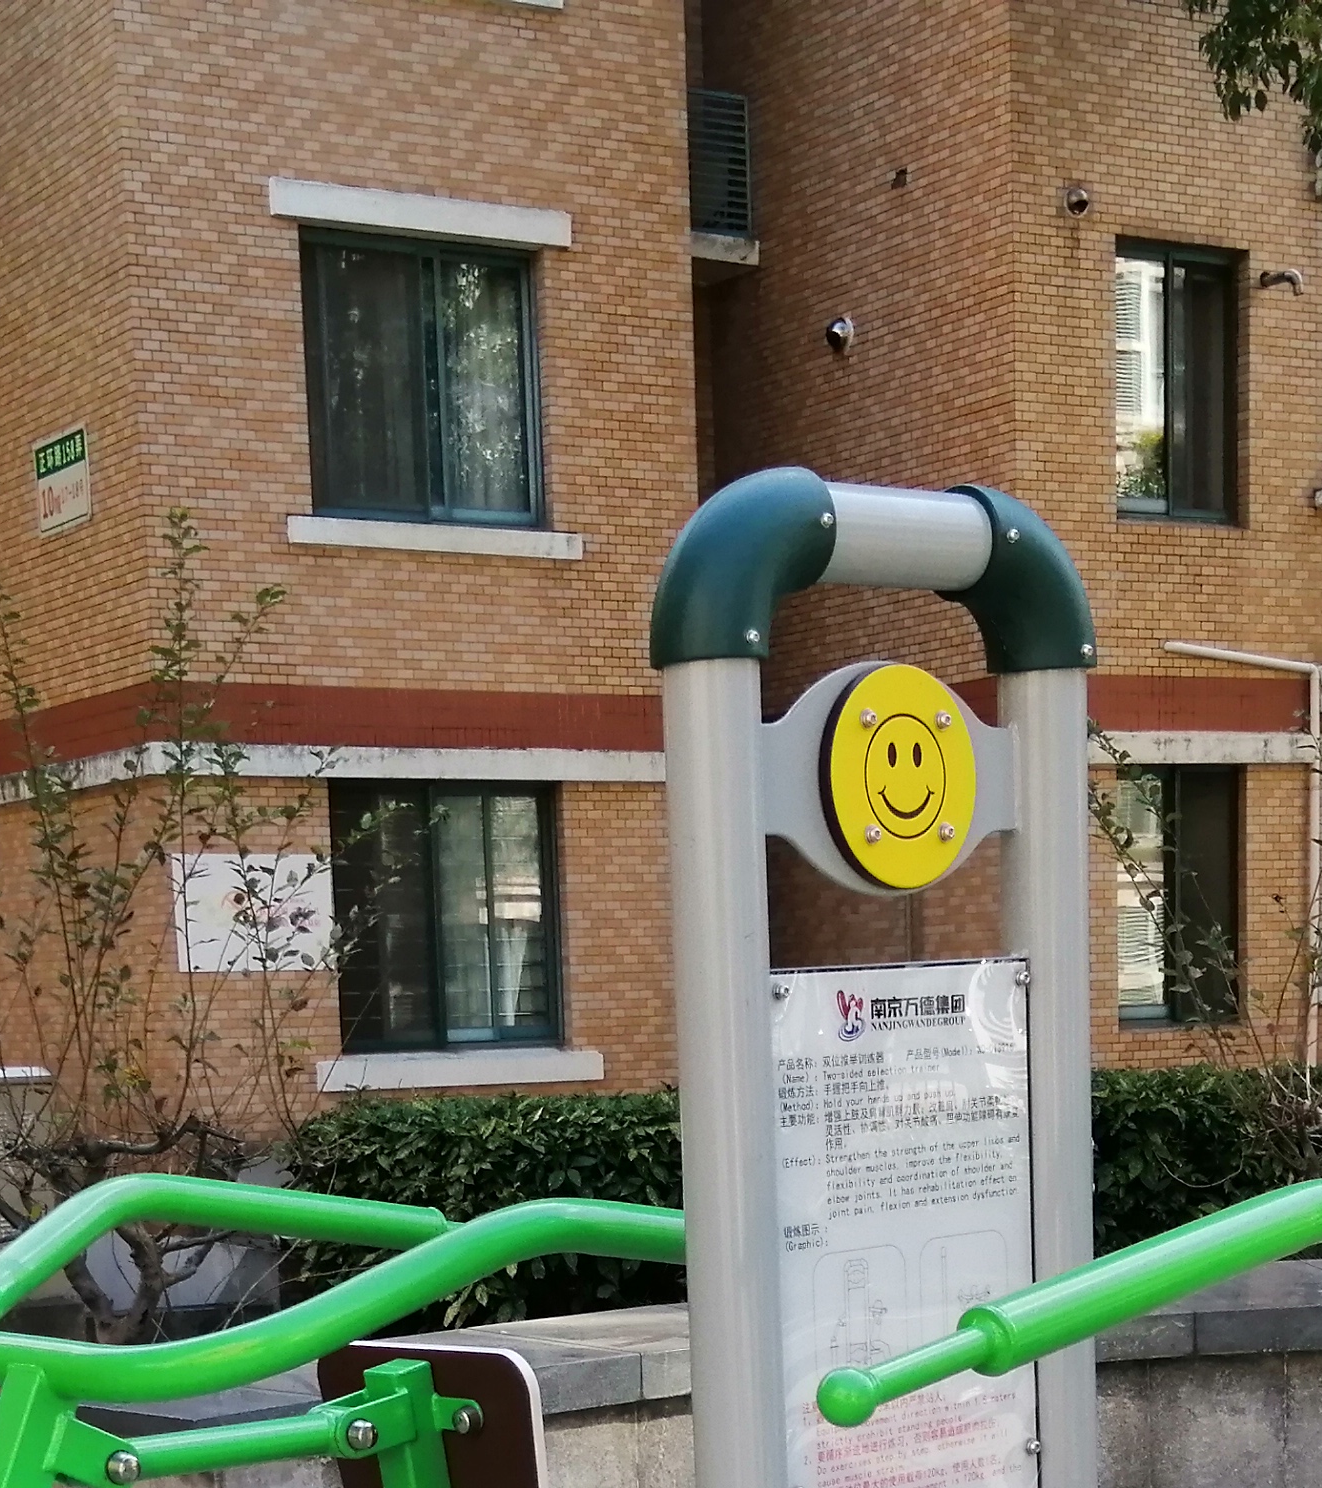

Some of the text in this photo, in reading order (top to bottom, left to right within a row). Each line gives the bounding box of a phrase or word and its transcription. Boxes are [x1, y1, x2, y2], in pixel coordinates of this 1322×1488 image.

[870, 994, 966, 1019] 南京万德集团
[871, 1016, 966, 1032] NANJINGWANDEGROUP
[823, 1097, 843, 1109] Hold
[845, 1097, 864, 1108] your
[874, 1148, 888, 1159] the
[929, 1140, 939, 1152] of
[942, 1141, 955, 1152] the
[826, 1165, 861, 1178] shoulder
[826, 1160, 1013, 1191] flexibility and coordination of shoulder and
[918, 1178, 976, 1194] rehabilitation
[980, 1174, 1005, 1187] effect
[828, 1208, 850, 1221] joint
[880, 1200, 911, 1212] flexion
[914, 1197, 928, 1208] and
[931, 1193, 970, 1205] extension
[817, 1436, 853, 1450] strictly
